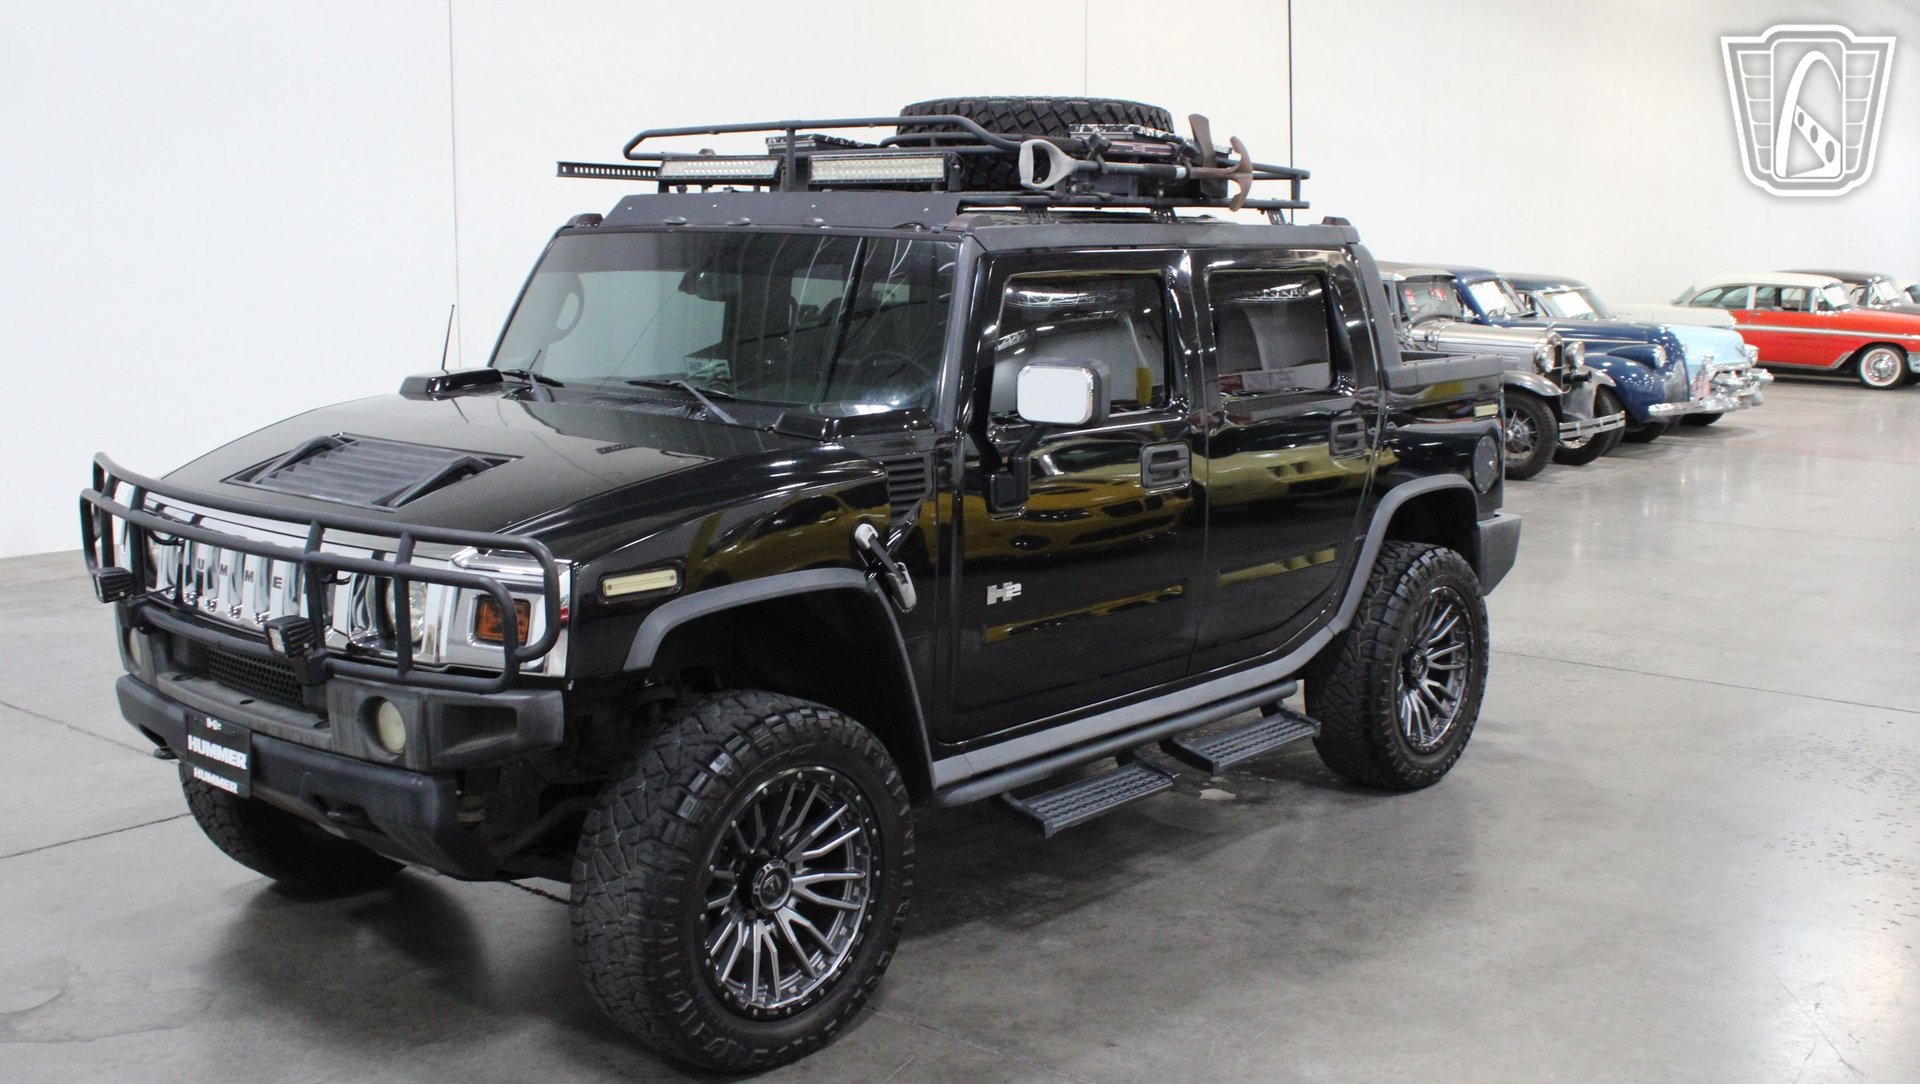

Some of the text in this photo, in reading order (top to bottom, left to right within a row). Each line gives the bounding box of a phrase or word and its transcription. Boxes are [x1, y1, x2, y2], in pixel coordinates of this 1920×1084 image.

[987, 581, 1022, 605] H2
[187, 734, 248, 770] HUMMER
[193, 767, 239, 794] HUMMER
